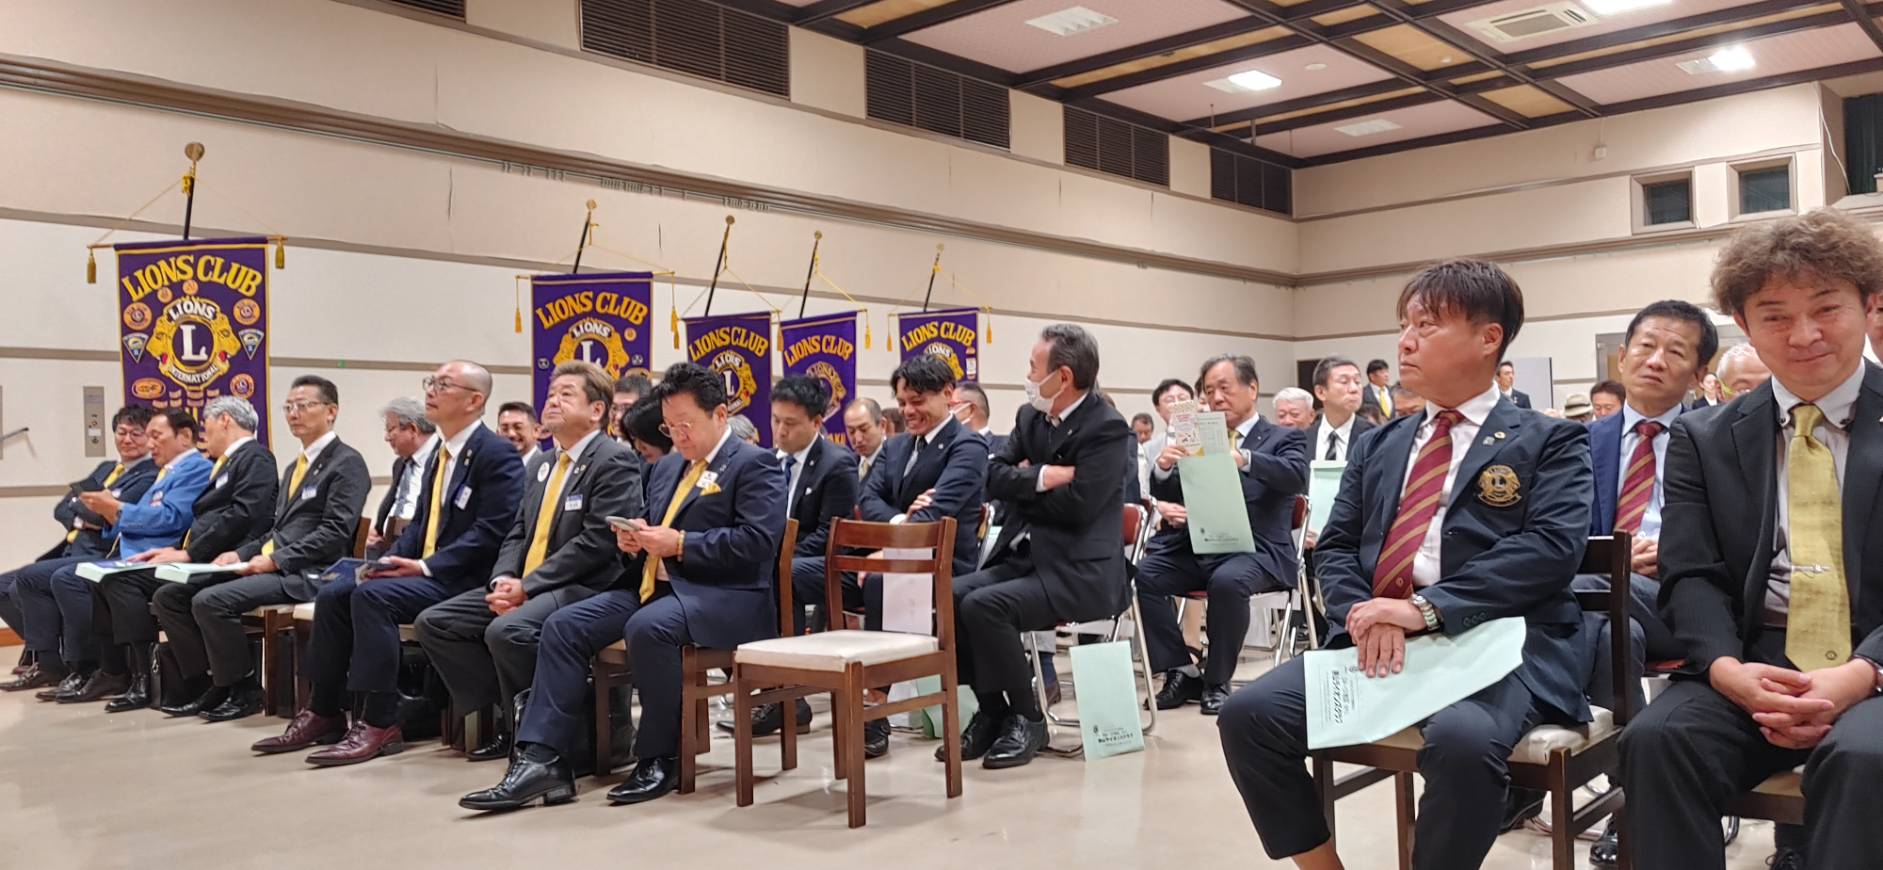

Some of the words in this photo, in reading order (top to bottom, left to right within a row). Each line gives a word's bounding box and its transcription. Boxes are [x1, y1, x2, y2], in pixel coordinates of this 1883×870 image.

[121, 254, 195, 302] LIONS
[197, 254, 263, 297] CLUB
[168, 300, 216, 321] LIONS
[535, 291, 594, 330] LIONS
[595, 291, 649, 326] CLUB
[180, 324, 208, 361] L
[572, 322, 611, 338] LIONS
[688, 327, 730, 362] LIONS
[730, 326, 769, 358] CLUB
[901, 321, 939, 352] LIONS
[940, 321, 976, 347] CLUB
[783, 336, 821, 368] LIONS
[821, 335, 854, 361] CLUB
[928, 345, 950, 358] IONS
